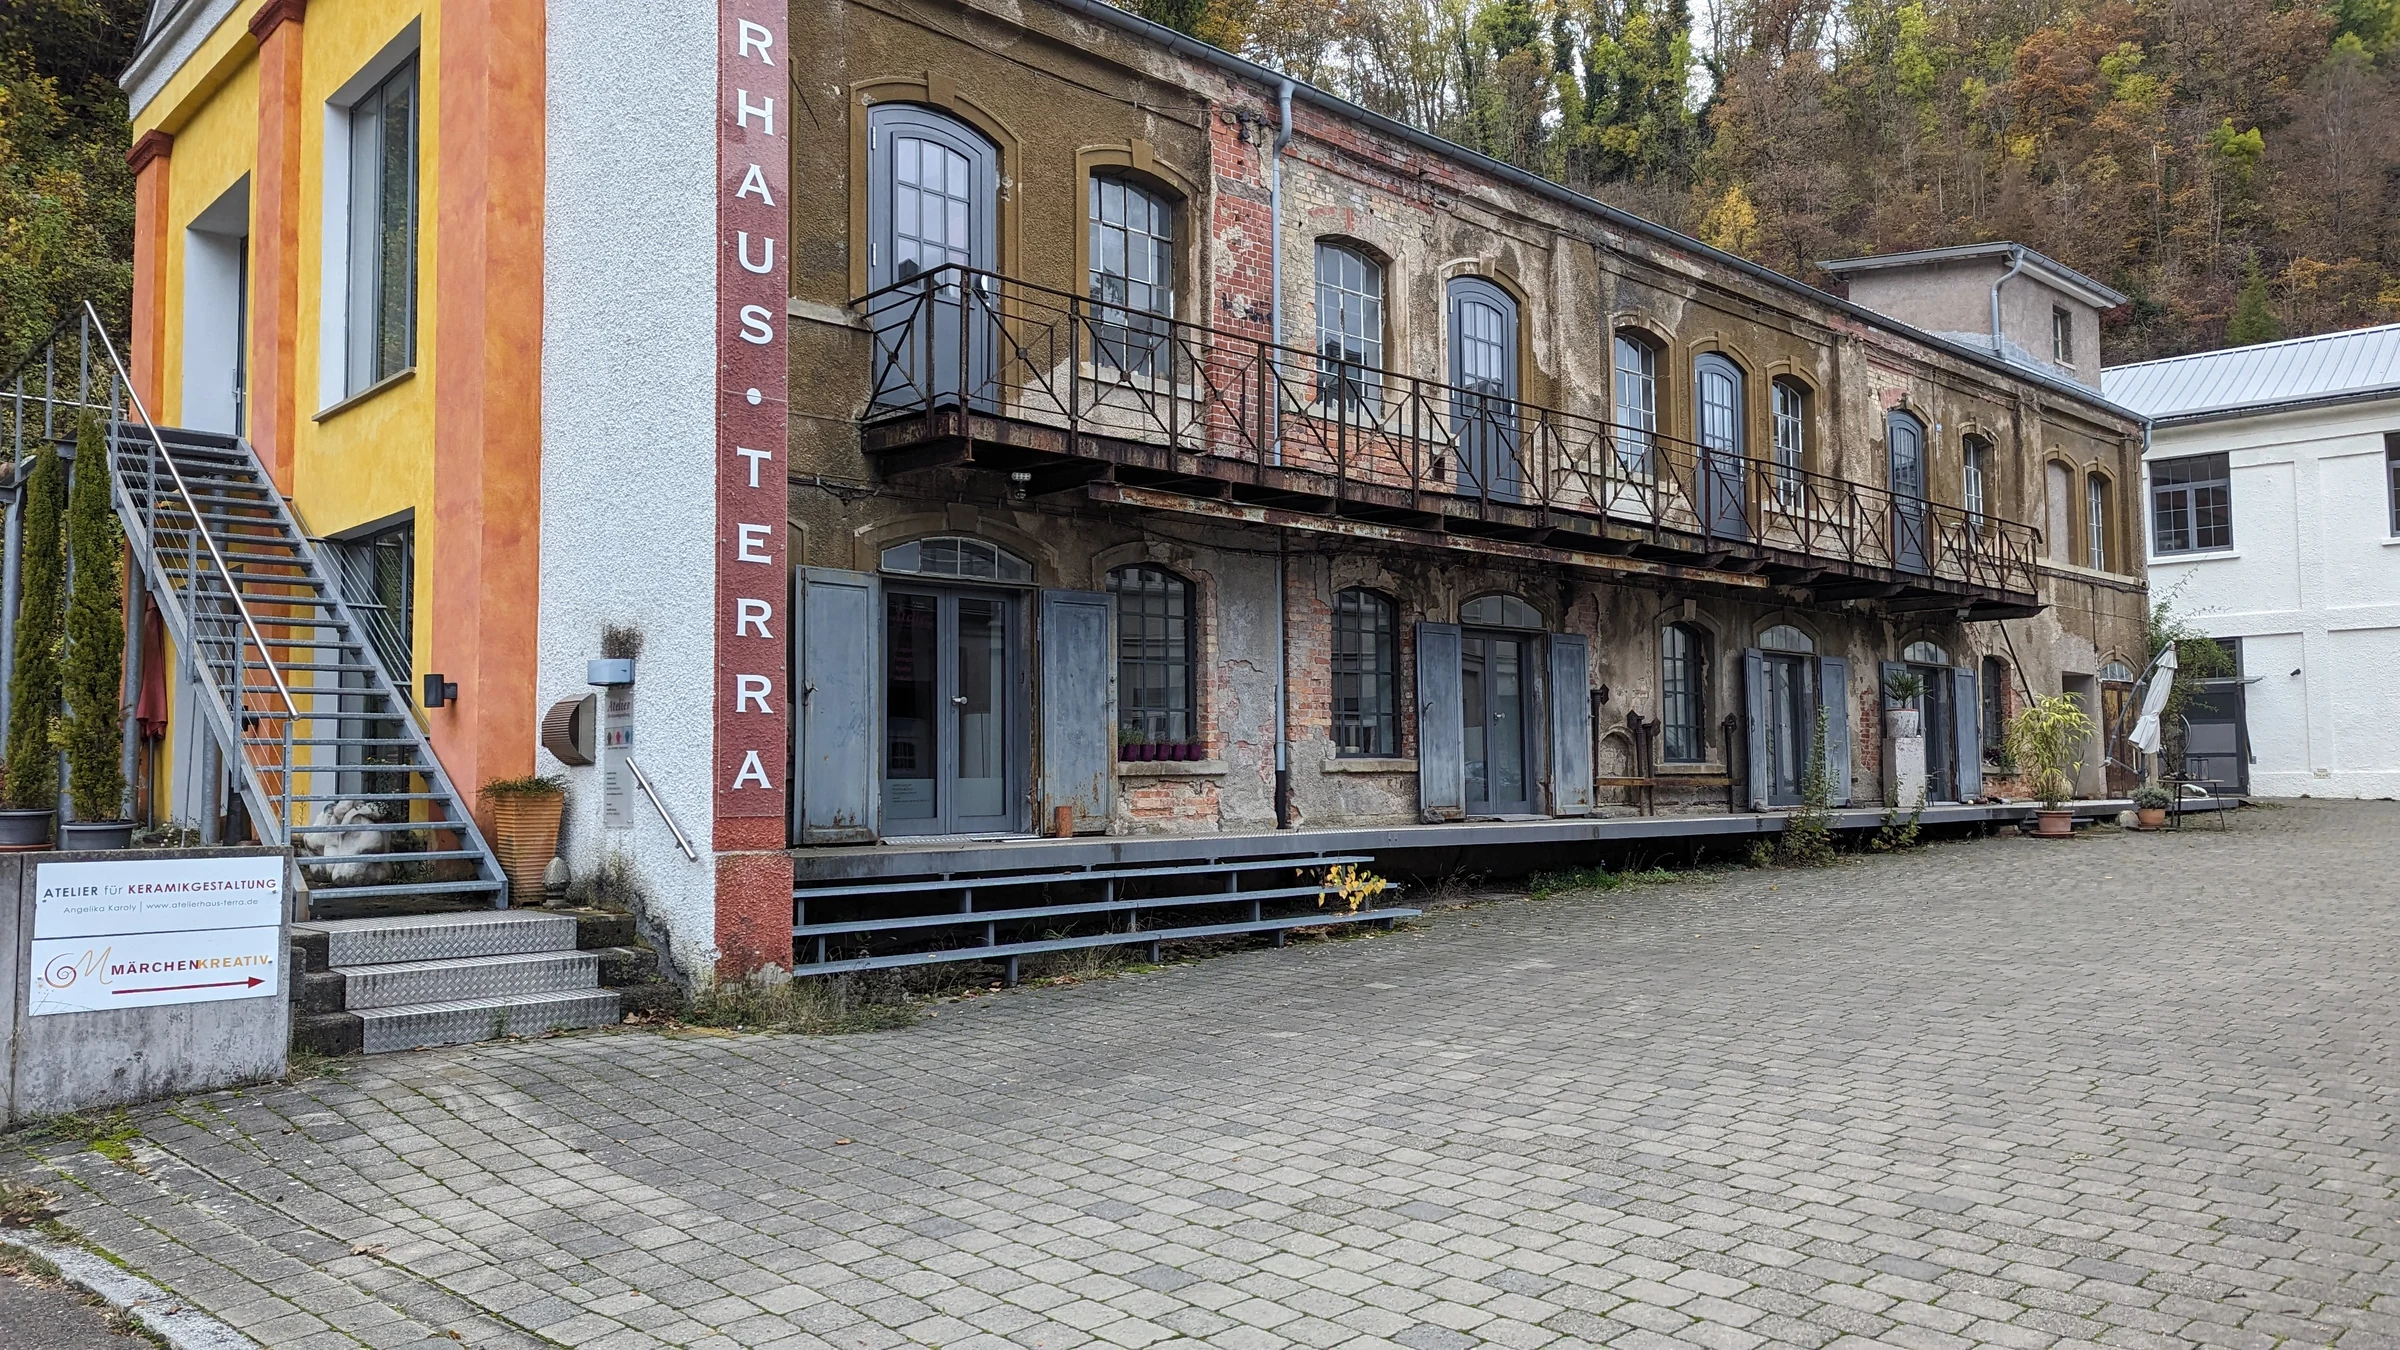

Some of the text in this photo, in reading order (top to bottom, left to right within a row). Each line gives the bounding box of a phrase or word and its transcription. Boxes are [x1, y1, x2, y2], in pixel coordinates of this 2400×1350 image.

[733, 446, 774, 790] TERRA
[43, 879, 276, 898] ATELIER für KERAMIKGESTALTUNG
[63, 898, 259, 914] Angelika Karoly www.atelierhaus-terra.de
